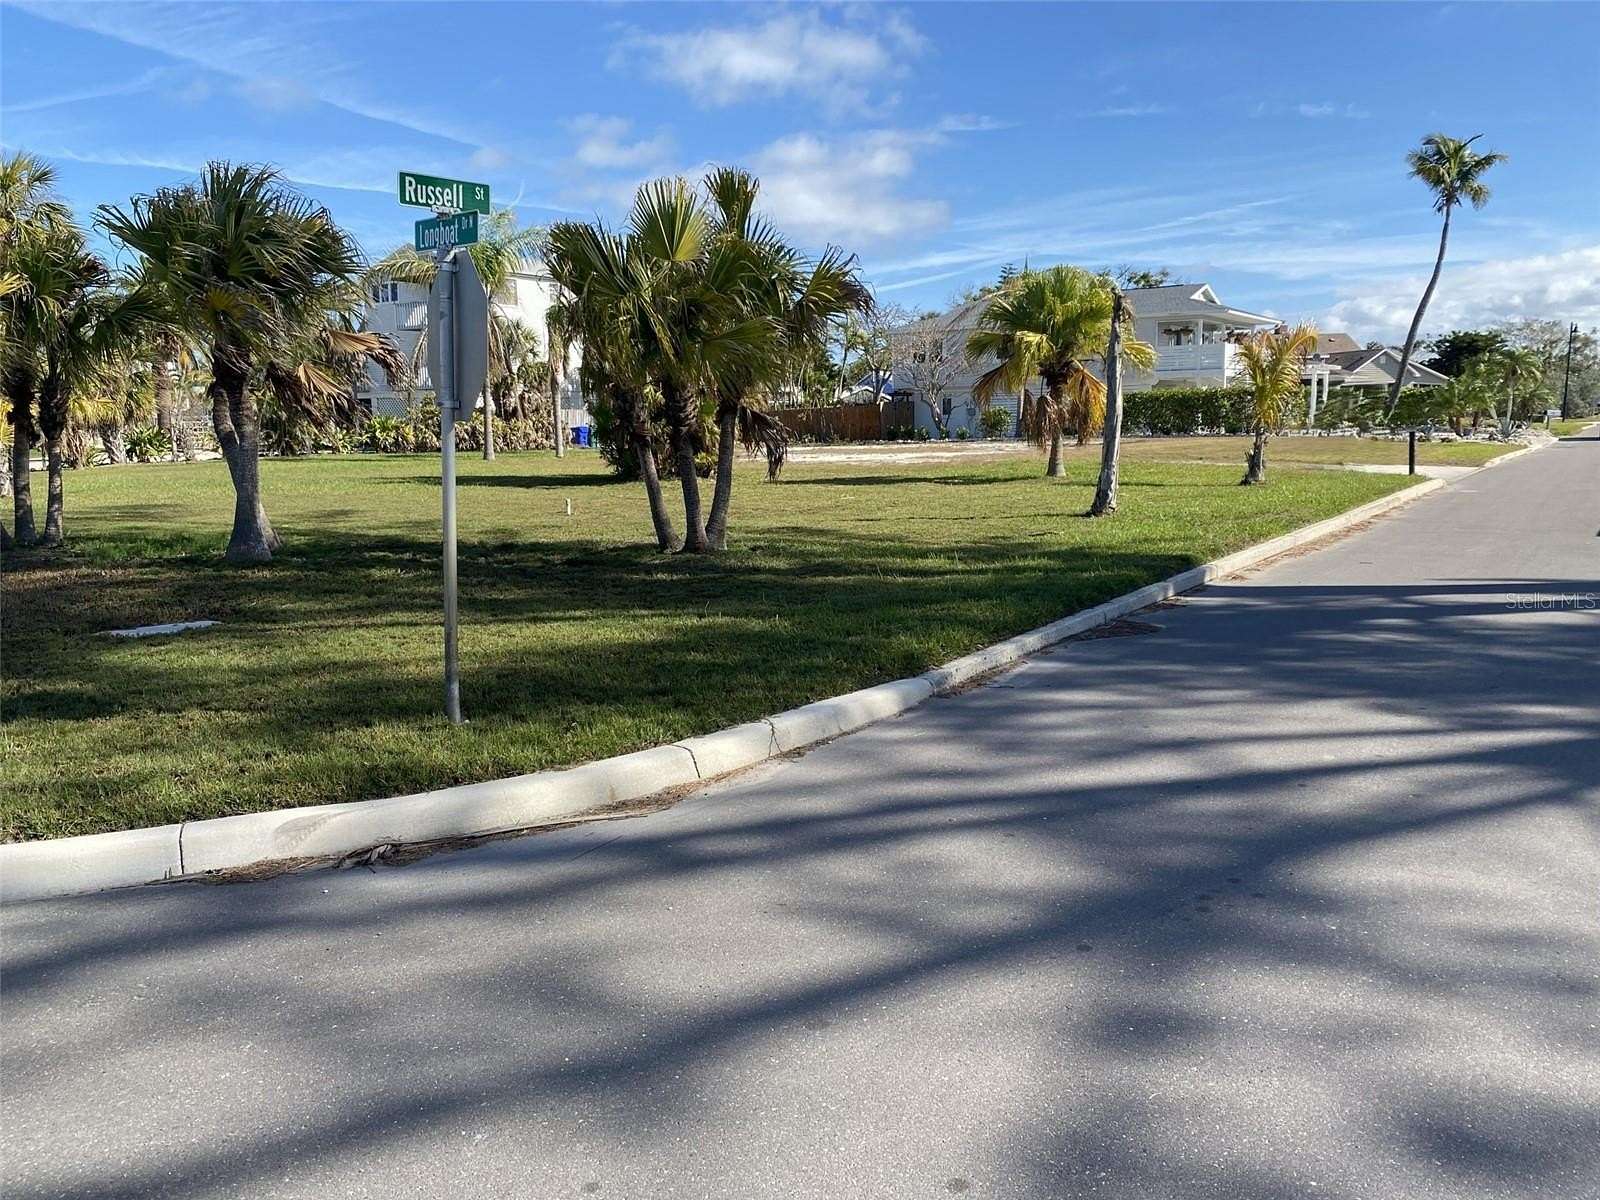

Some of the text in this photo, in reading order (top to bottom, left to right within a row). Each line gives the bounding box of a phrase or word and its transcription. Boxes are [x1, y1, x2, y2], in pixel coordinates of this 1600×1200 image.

[405, 176, 484, 208] Russell St
[420, 219, 458, 249] Longboat
